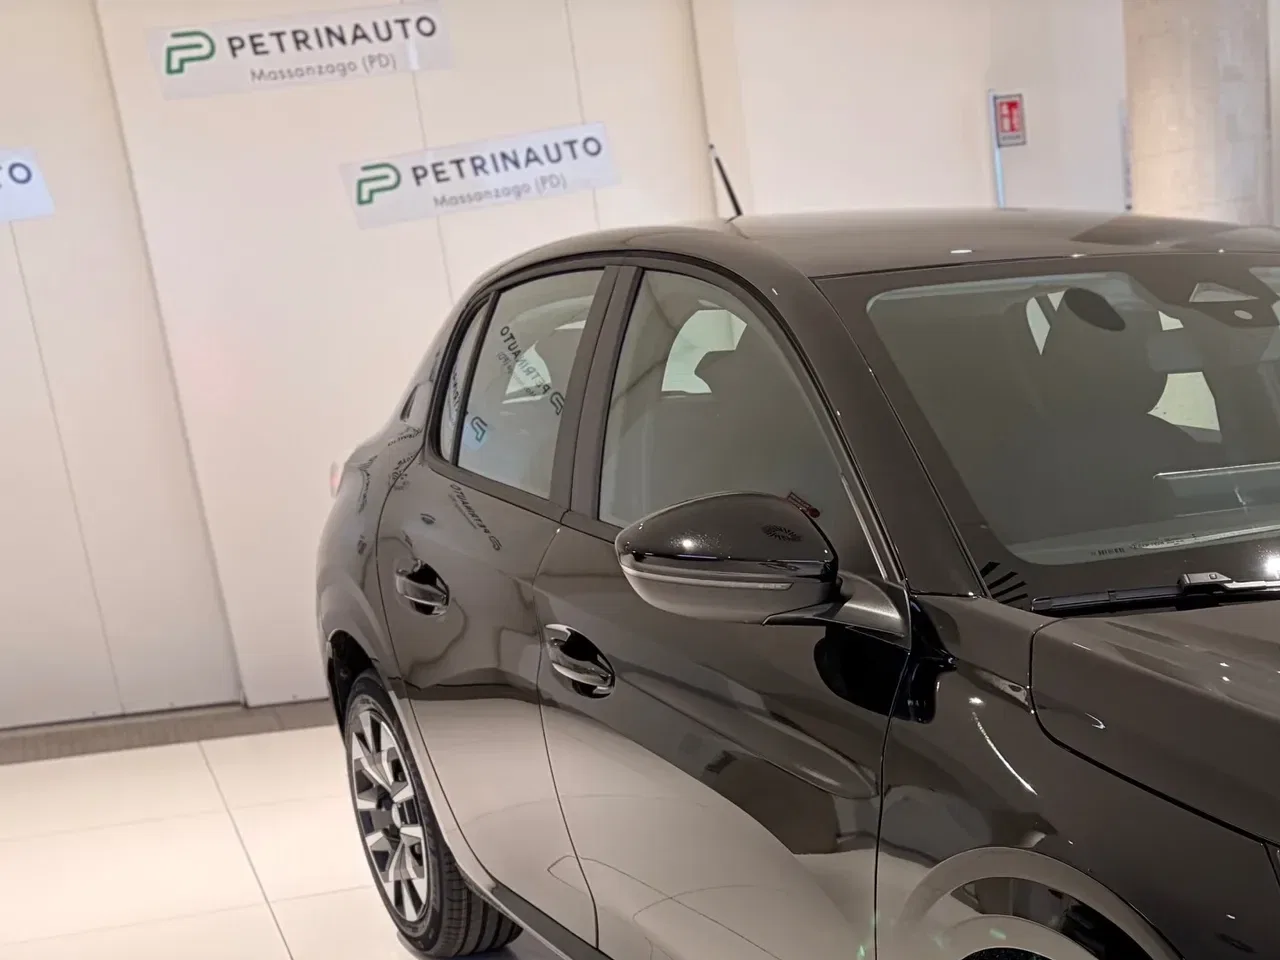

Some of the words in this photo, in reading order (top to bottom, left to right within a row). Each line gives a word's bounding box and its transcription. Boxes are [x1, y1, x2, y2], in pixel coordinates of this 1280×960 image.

[226, 16, 437, 58] PETRINAUTO
[250, 60, 357, 83] Massanzago
[361, 52, 397, 74] (PD)
[411, 136, 602, 187] PETRINAUTO
[433, 182, 531, 209] Massanzago
[535, 172, 568, 196] (PD)
